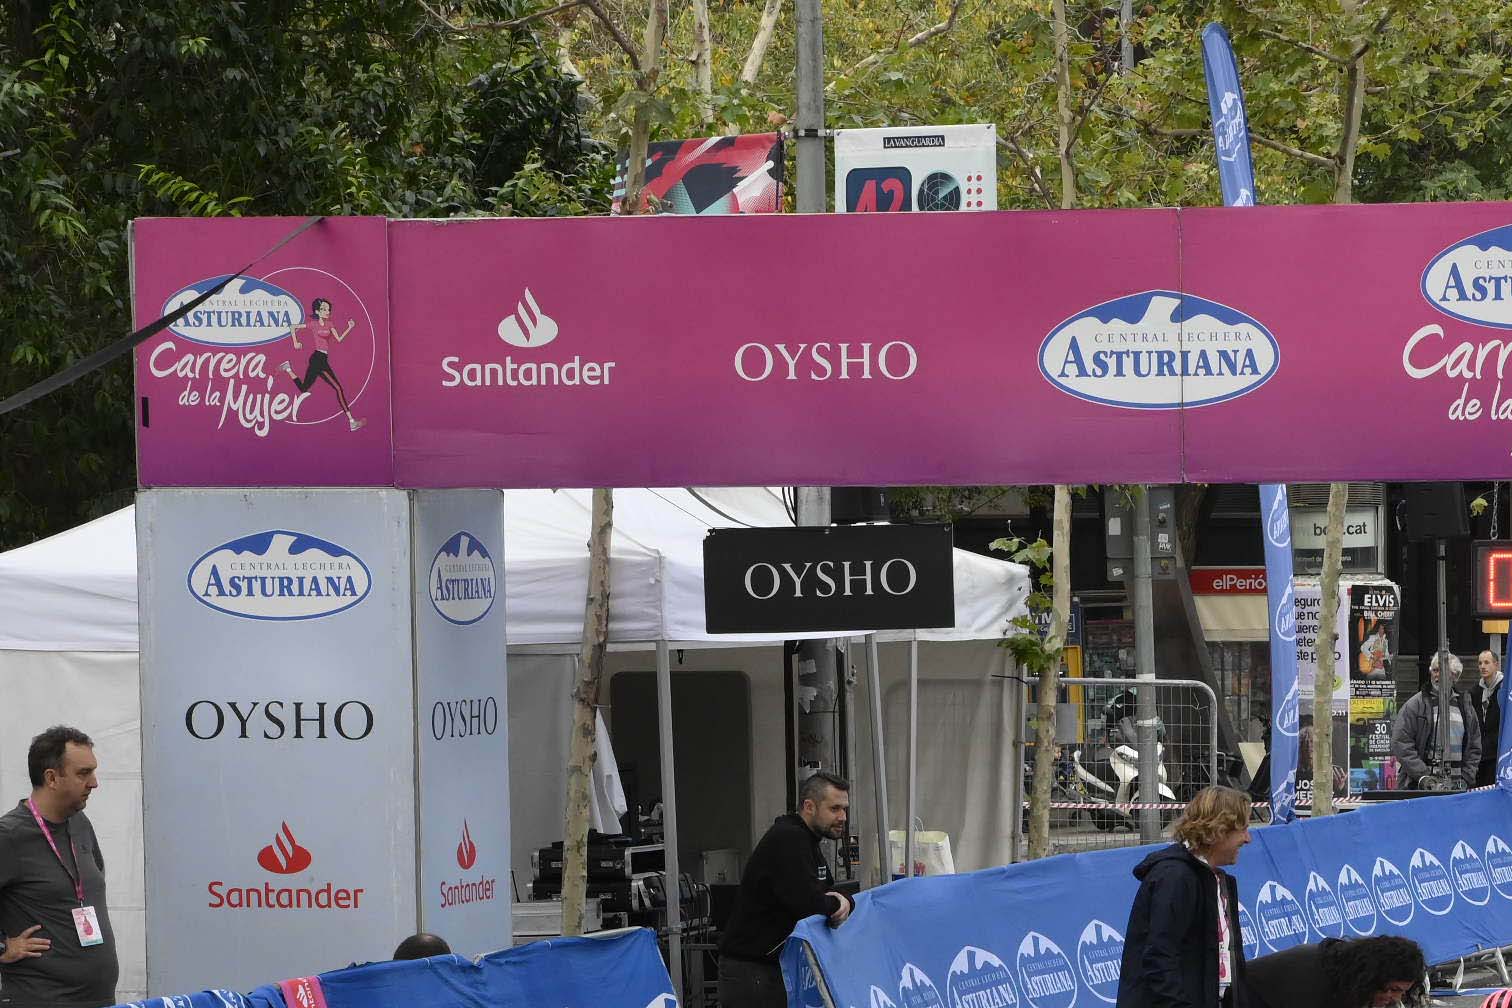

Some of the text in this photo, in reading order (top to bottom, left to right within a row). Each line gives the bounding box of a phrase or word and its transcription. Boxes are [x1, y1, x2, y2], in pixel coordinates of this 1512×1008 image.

[200, 299, 239, 307] ENTRAL
[1095, 331, 1253, 344] CENTRAL LECHERA
[149, 341, 267, 379] Carrera
[442, 357, 615, 386] Santander
[734, 341, 918, 382] OYSHO
[1057, 335, 1261, 378] ASTURIANA
[178, 374, 312, 438] de la Mujer
[1448, 382, 1483, 421] de
[202, 564, 358, 599] ASTURIANA
[230, 561, 352, 572] CENTRAL LECHERA
[435, 565, 492, 602] ASTURIANA
[744, 558, 917, 600] OYSHO
[1212, 574, 1266, 590] elPerió
[1363, 593, 1395, 607] ELVIS
[185, 700, 374, 740] OYSHO
[431, 696, 498, 740] OYSHO
[1374, 724, 1387, 734] 30
[208, 881, 365, 909] Santander
[440, 875, 497, 909] Santander
[1022, 966, 1074, 999] ASTURIANA
